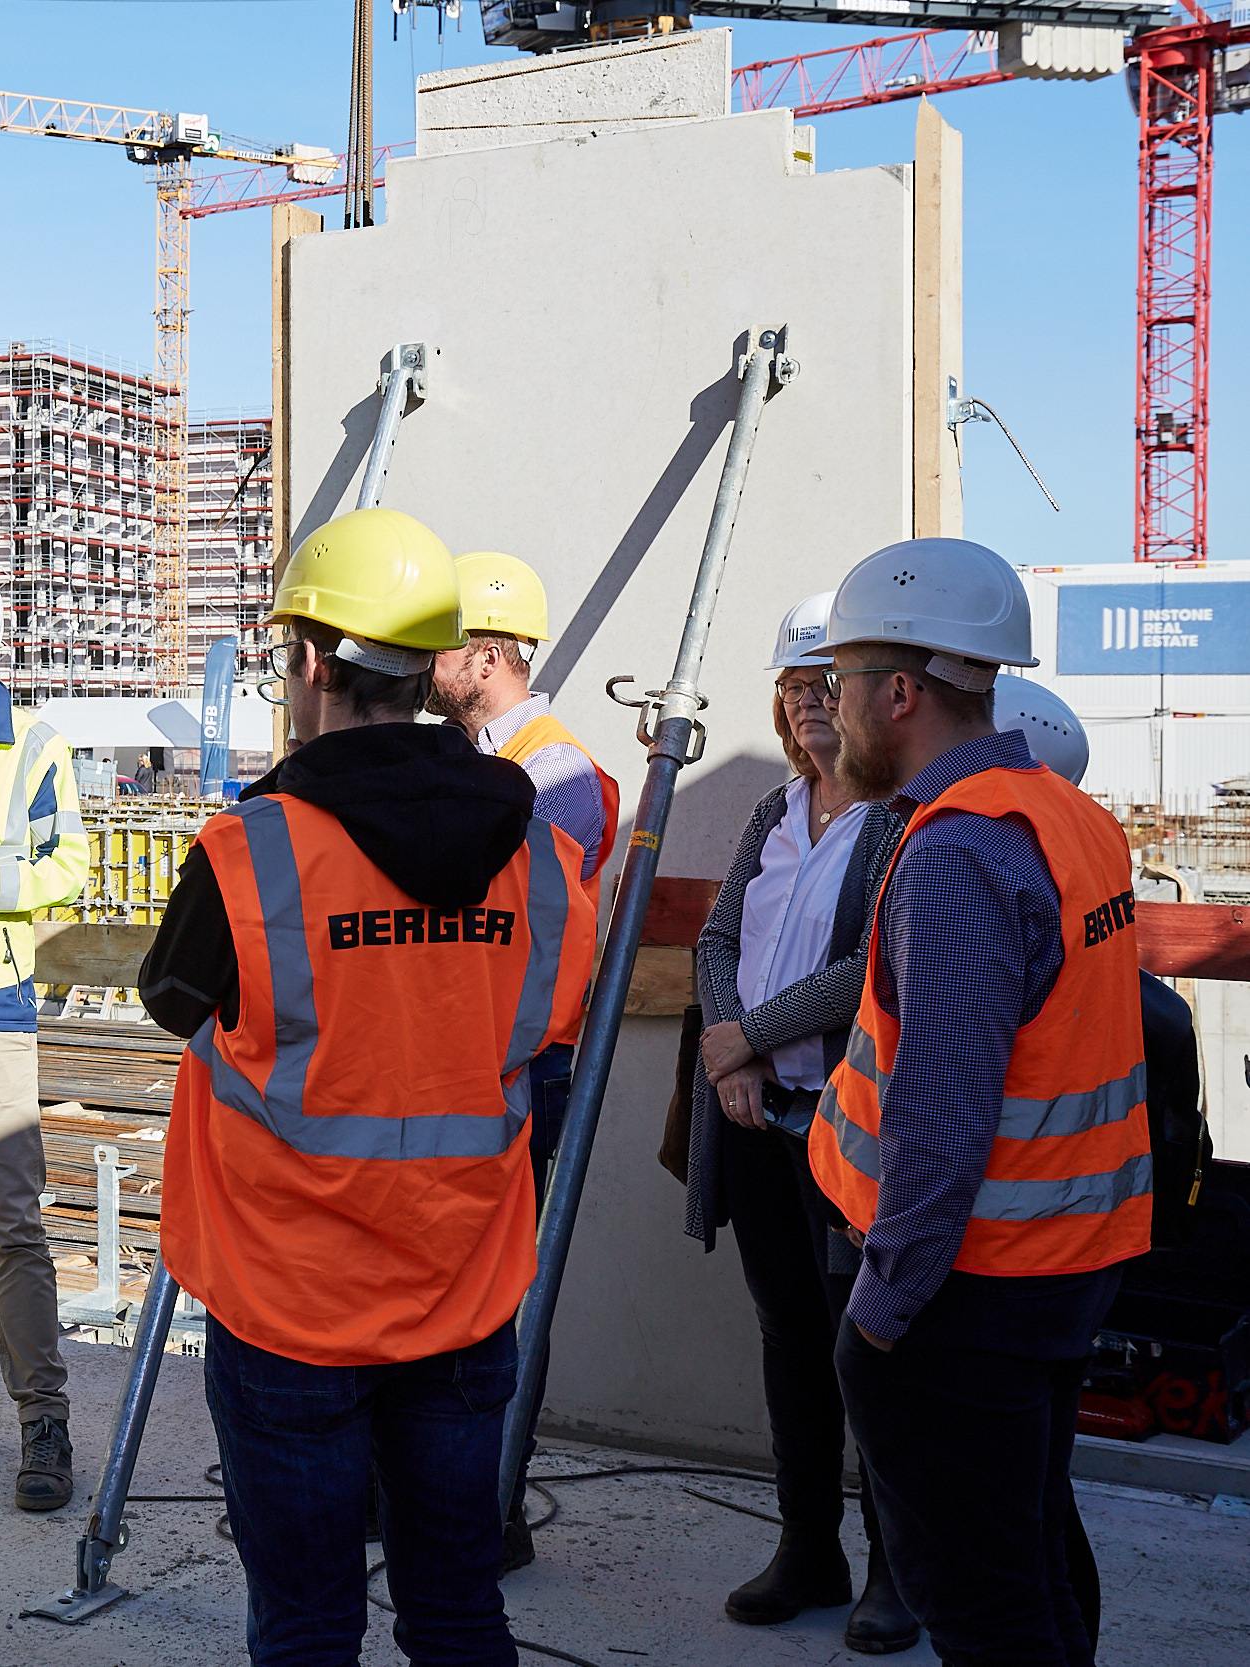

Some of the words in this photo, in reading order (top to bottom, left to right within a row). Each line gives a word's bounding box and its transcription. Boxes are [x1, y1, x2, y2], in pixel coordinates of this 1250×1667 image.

[1142, 608, 1214, 622] INSTONE
[1142, 621, 1183, 634] REAL
[1142, 634, 1199, 647] ESTATE
[204, 705, 218, 739] OFB
[327, 907, 516, 950] BERGER
